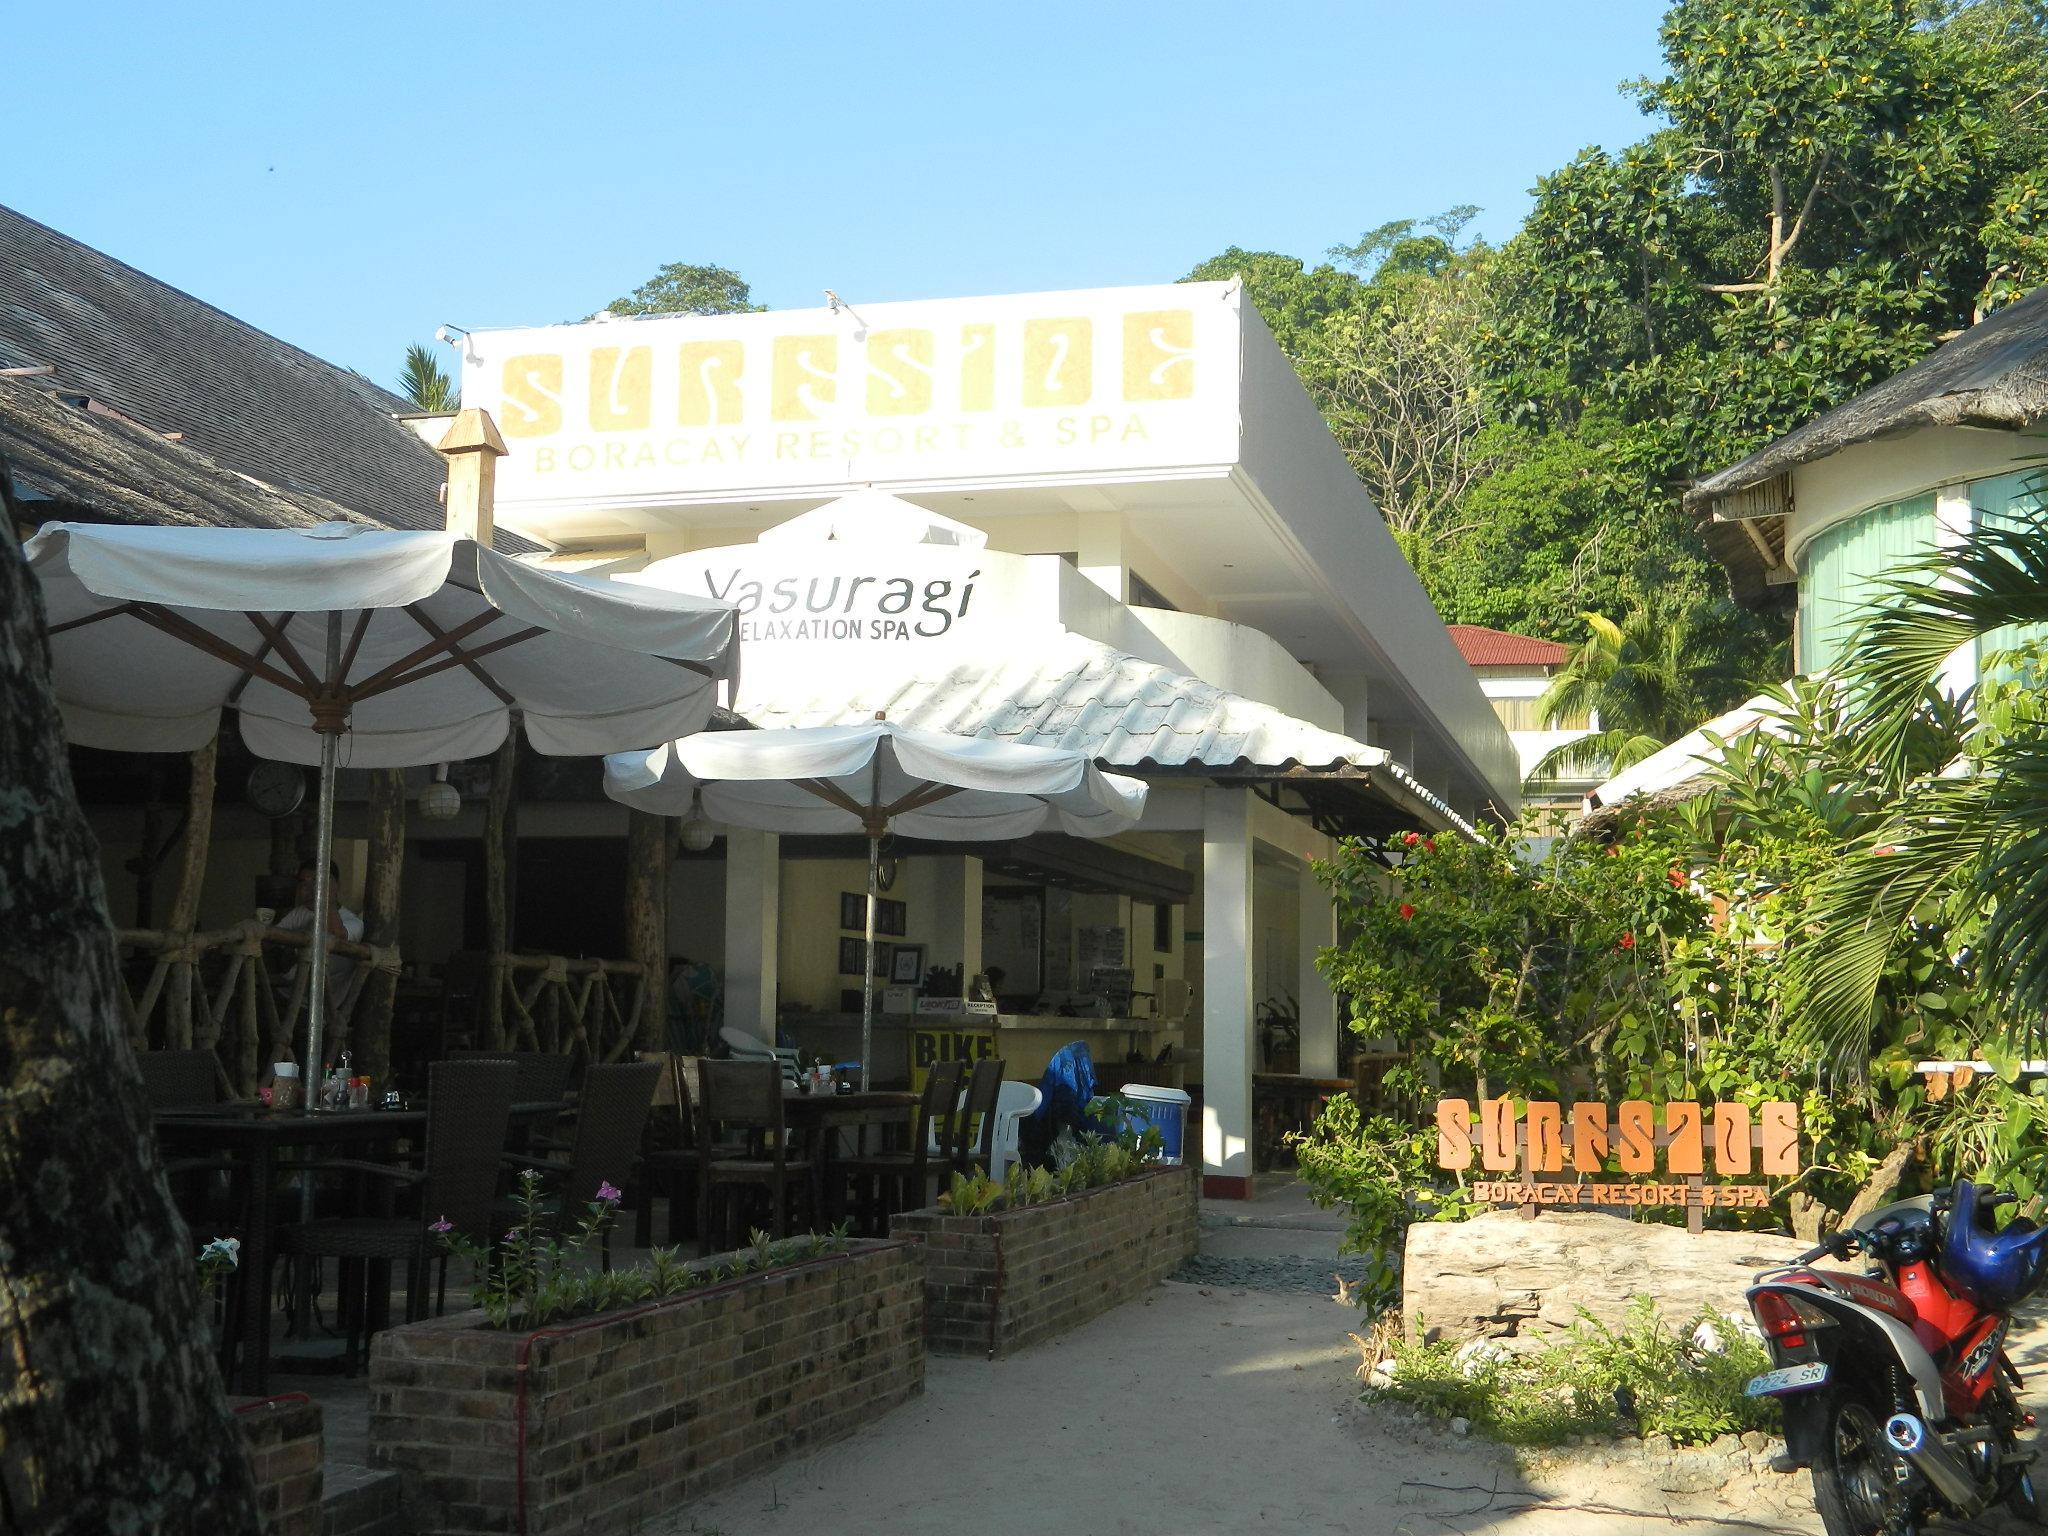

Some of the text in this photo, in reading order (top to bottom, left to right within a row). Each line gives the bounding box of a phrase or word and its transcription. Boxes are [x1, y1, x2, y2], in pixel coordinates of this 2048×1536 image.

[500, 309, 1196, 438] SURFSIDE
[534, 412, 1150, 474] BORACAY RESORT & SPA
[740, 619, 909, 641] ELAXATION SPA
[915, 1032, 993, 1069] BIKE
[1437, 1098, 1799, 1175] SURFSIDE
[1474, 1182, 1769, 1207] BORACAY RESORT & SPA
[1851, 1283, 1897, 1310] HONDA
[1801, 1368, 1820, 1380] SR
